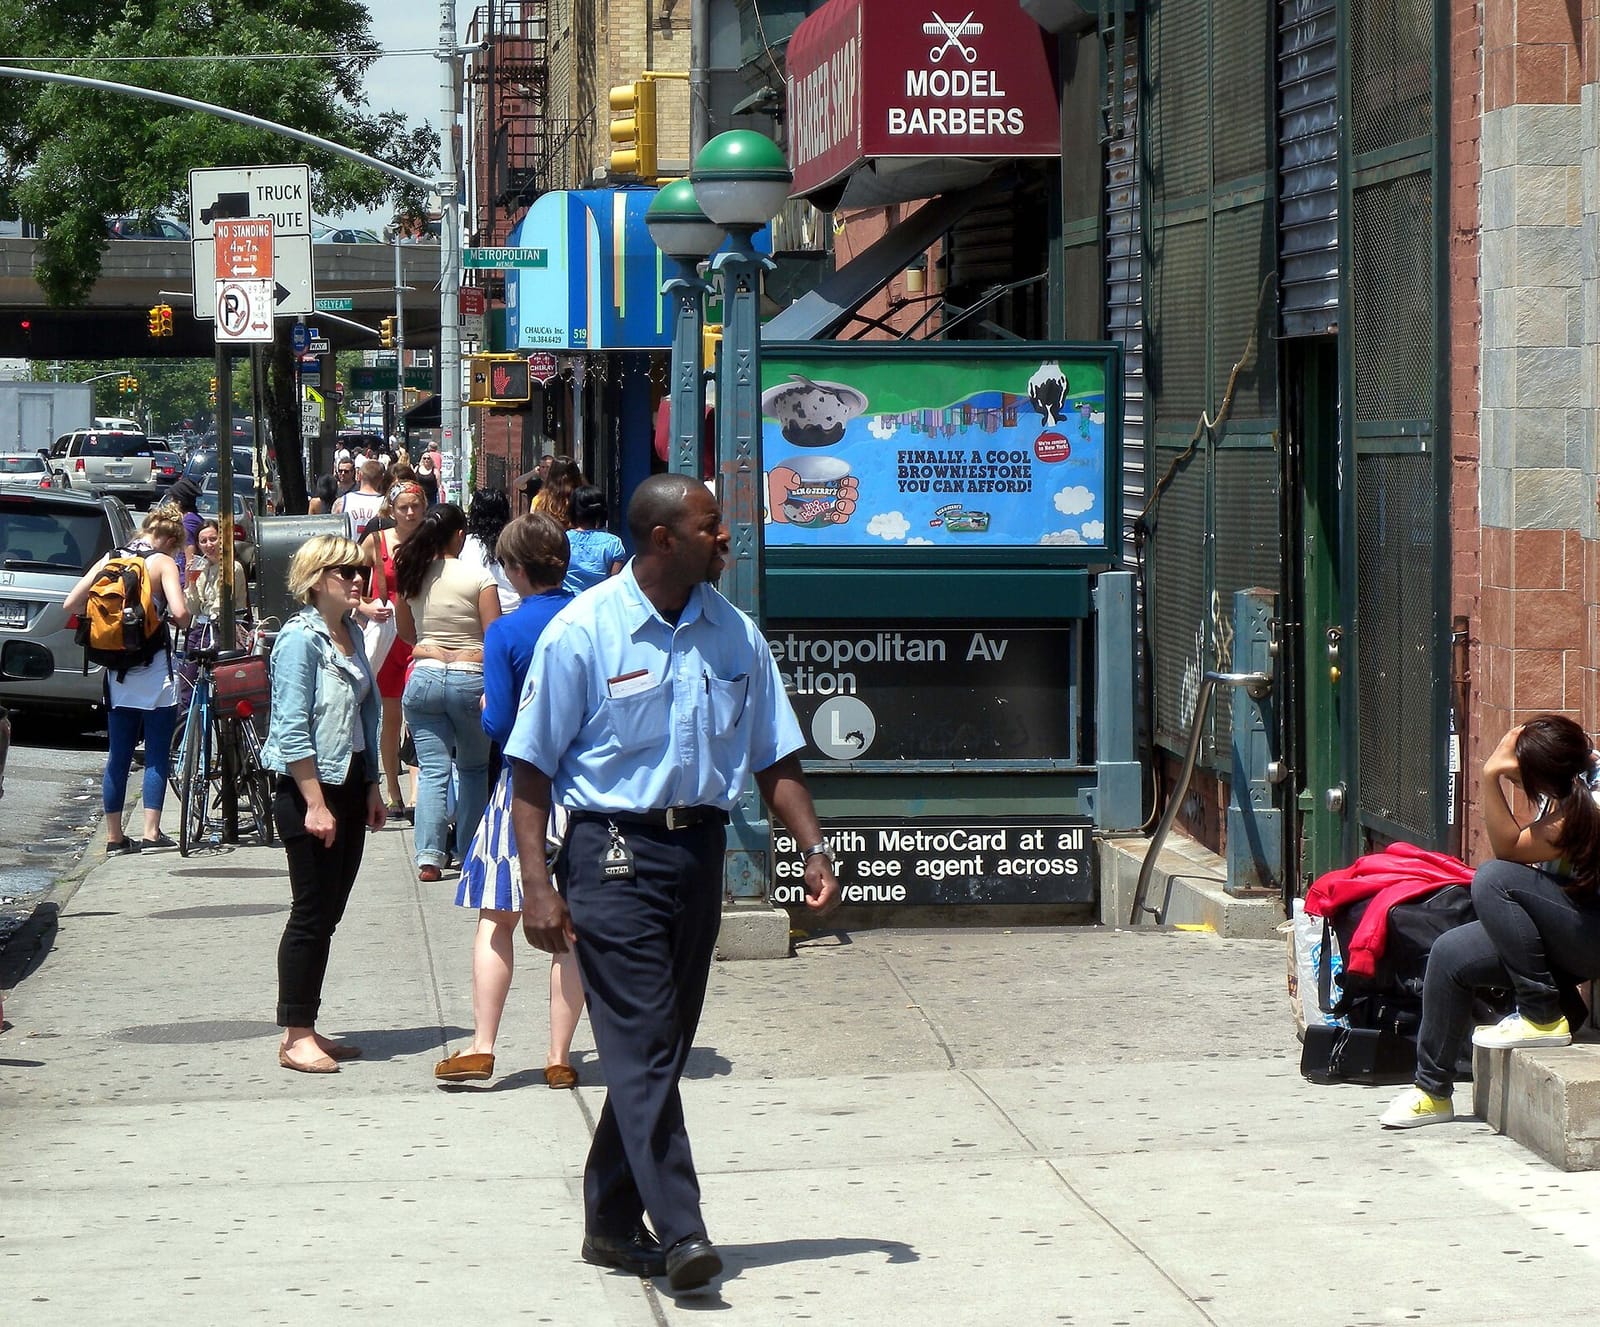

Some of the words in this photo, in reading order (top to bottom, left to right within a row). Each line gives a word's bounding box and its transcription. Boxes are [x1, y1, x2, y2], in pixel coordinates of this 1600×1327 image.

[906, 69, 1006, 97] MODEL
[797, 61, 831, 166] BARBER
[831, 37, 857, 146] SHOP
[888, 107, 1025, 135] BARBERS
[256, 185, 302, 201] TRUCK
[218, 225, 229, 238] NO
[232, 224, 270, 238] STANDING
[470, 249, 540, 260] METROPOLITAN
[573, 328, 587, 339] 519
[971, 450, 982, 464] A
[986, 450, 1031, 464] COOL
[897, 465, 1032, 479] BROWNIESTONE
[897, 480, 930, 493] YOU
[932, 480, 965, 493] CAN
[967, 480, 1032, 493] AFFORD!
[770, 633, 946, 669] etropolitan
[965, 632, 1009, 661] Av
[831, 710, 861, 746] L
[878, 829, 1007, 852] MetroCard
[1019, 829, 1044, 851] at
[1057, 829, 1084, 850] all
[775, 860, 805, 878] es
[857, 860, 902, 878] see
[914, 854, 984, 881] agent
[997, 857, 1079, 876] across
[841, 884, 907, 903] venue
